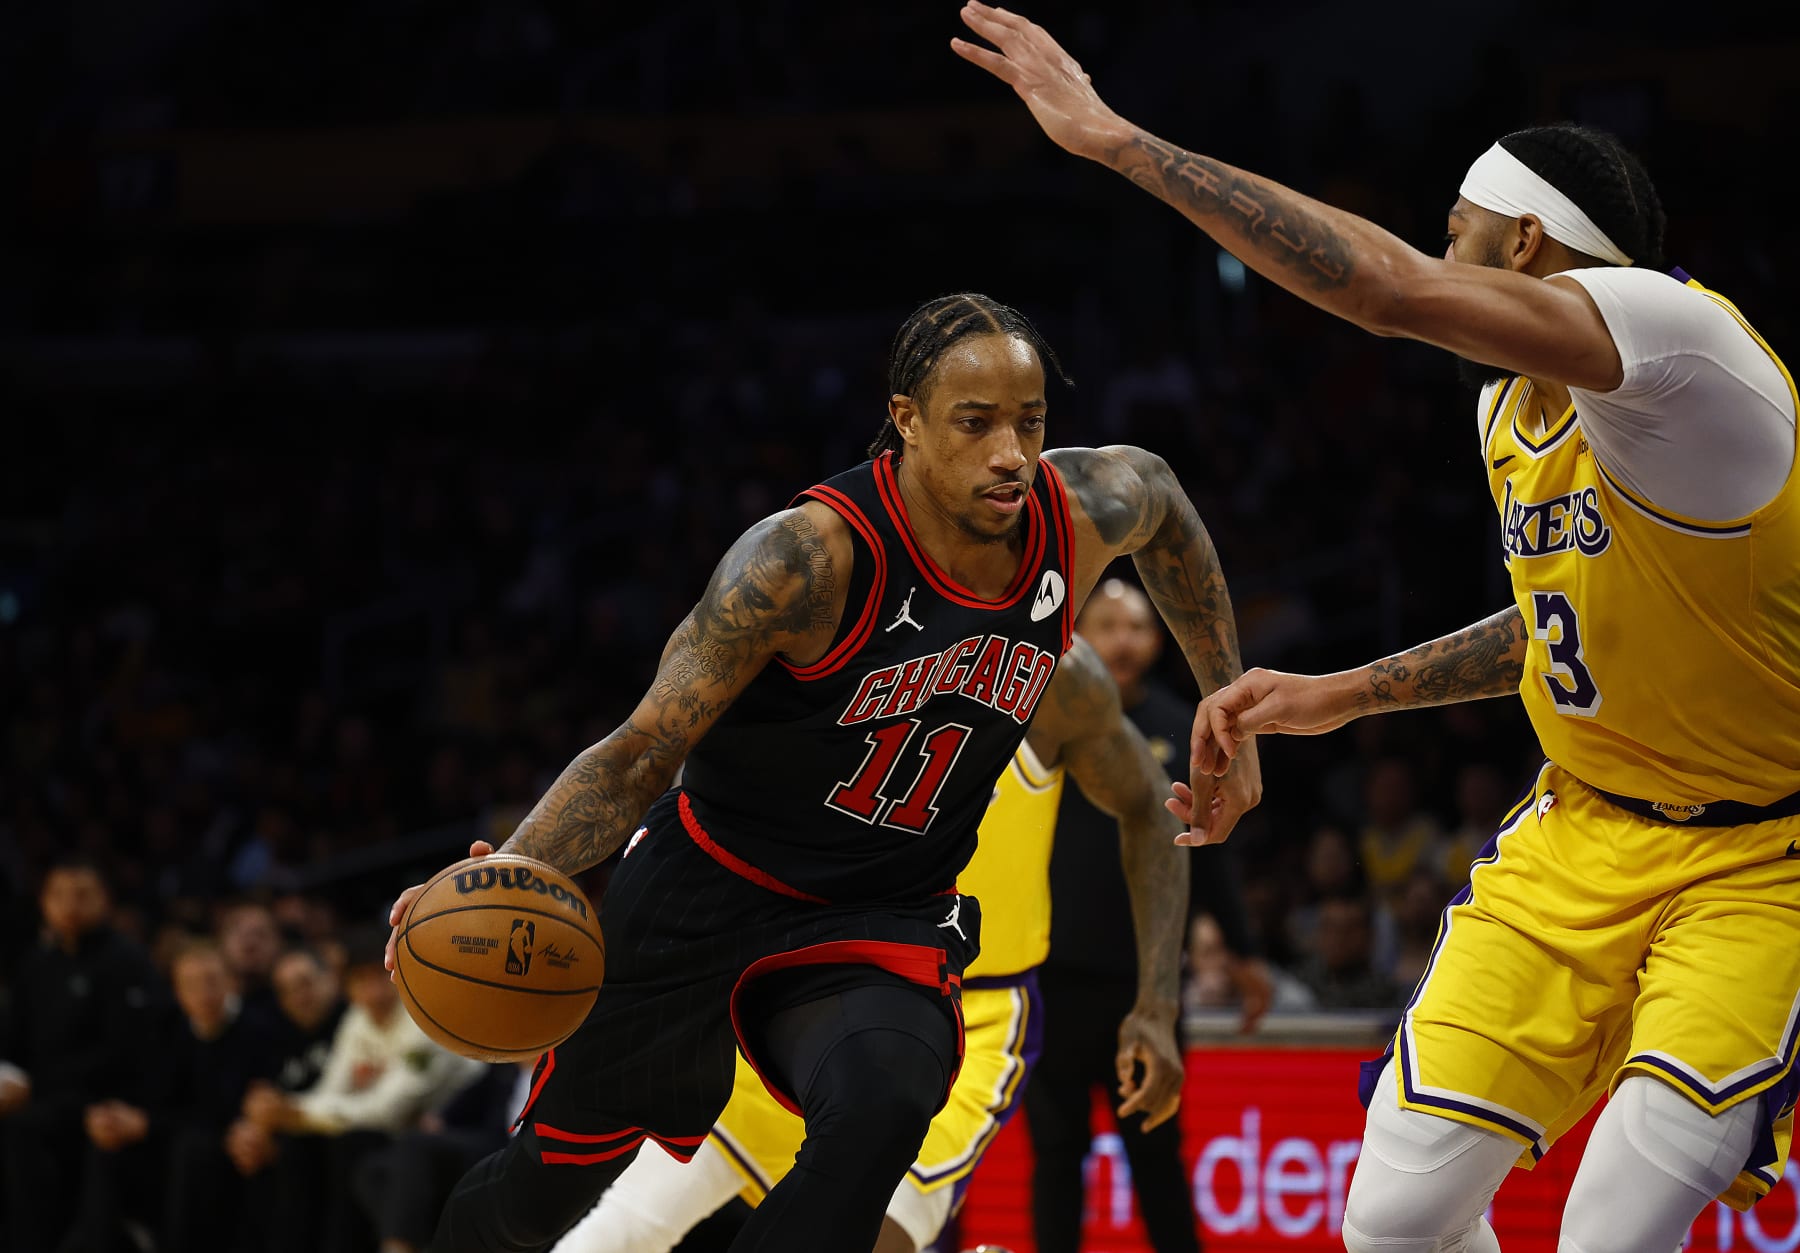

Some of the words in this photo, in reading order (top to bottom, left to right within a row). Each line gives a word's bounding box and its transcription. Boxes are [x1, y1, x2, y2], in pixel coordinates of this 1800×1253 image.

[837, 634, 1055, 725] CHICAGO
[1532, 590, 1603, 717] 3
[824, 718, 973, 835] 11
[452, 867, 588, 922] Wilson
